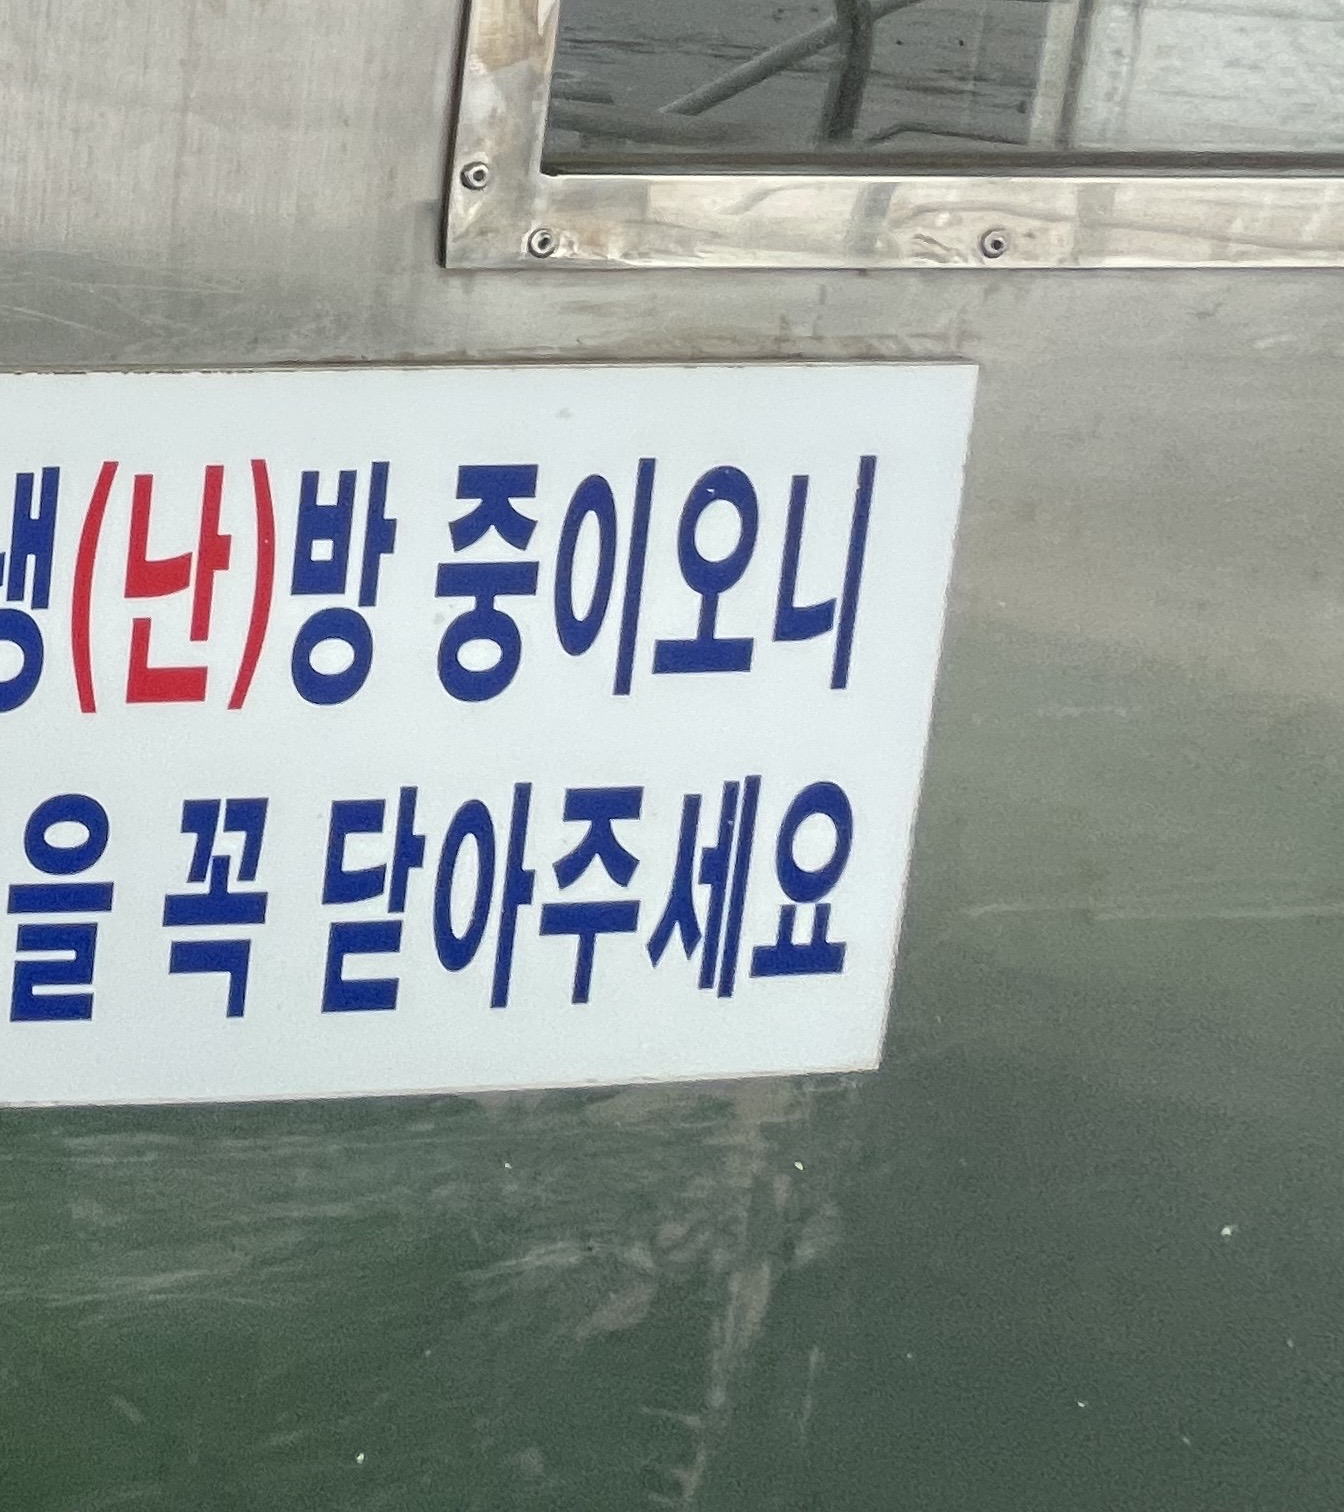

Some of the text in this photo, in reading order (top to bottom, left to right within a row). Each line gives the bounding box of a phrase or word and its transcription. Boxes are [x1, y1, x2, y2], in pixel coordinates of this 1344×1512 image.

[435, 455, 877, 702] 중이오니
[162, 798, 268, 1018] 꼭
[321, 775, 853, 1014] 닫아주세요
